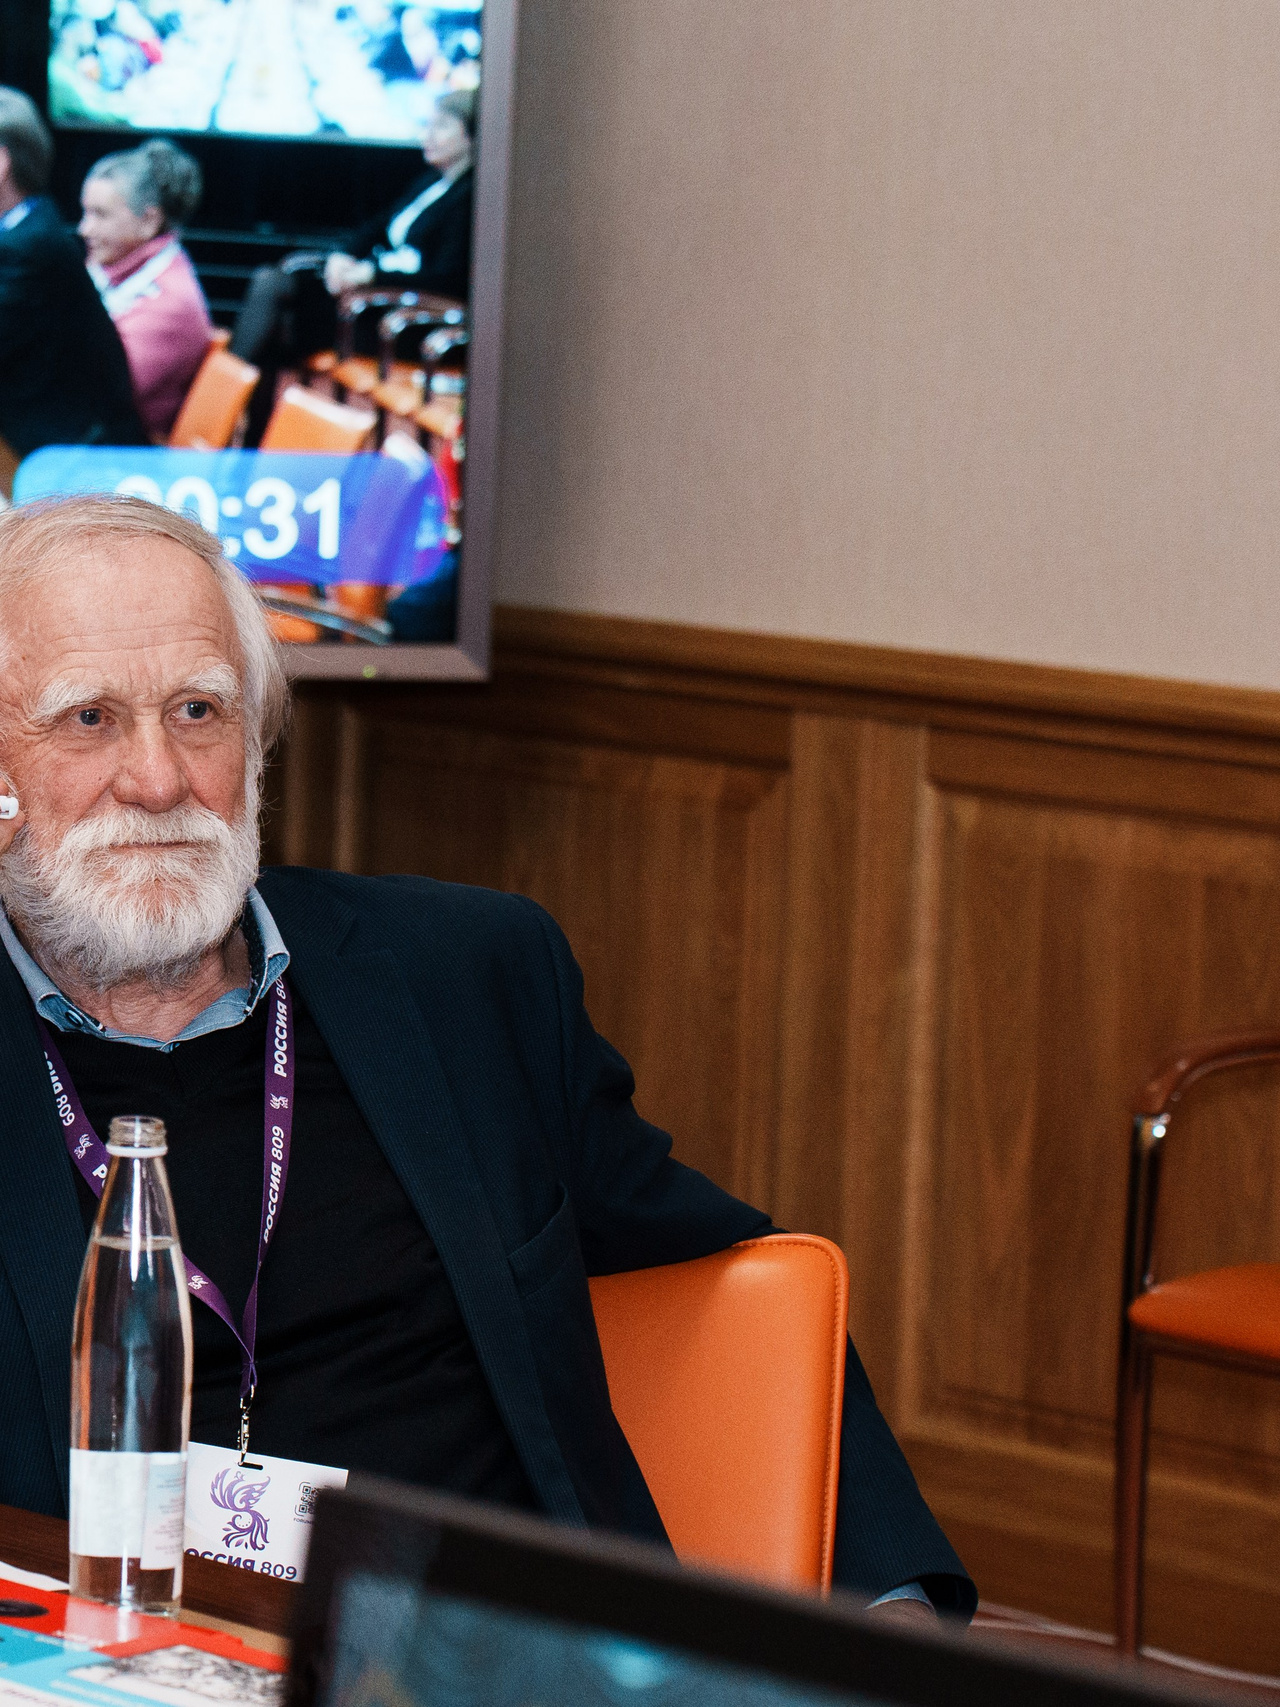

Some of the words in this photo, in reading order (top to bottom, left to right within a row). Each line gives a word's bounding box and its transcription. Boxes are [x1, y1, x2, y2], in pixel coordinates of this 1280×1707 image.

[115, 475, 341, 560] 0:31
[275, 976, 287, 1000] 80
[273, 1000, 288, 1078] РОССИЯ
[55, 1094, 76, 1127] 809
[271, 1125, 285, 1161] 809
[263, 1161, 283, 1244] РОССИЯ
[184, 1548, 256, 1572] ОССИЯ
[260, 1561, 298, 1581] 809
